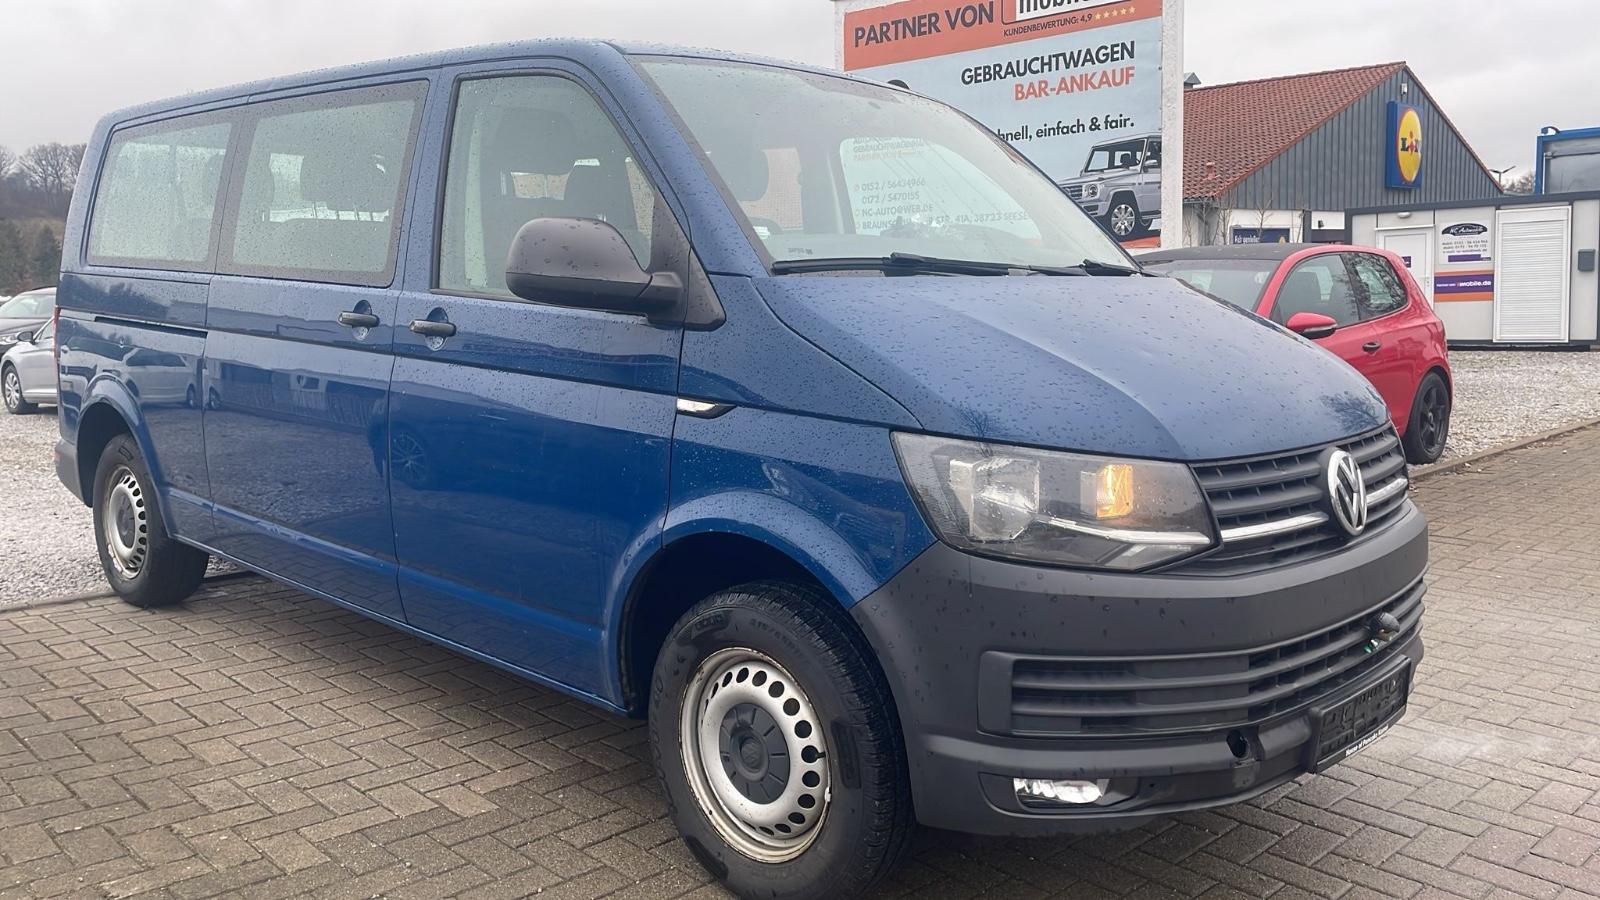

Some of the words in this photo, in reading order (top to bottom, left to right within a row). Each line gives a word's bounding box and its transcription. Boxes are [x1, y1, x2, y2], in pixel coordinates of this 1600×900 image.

[854, 12, 941, 48] PARTNER
[945, 1, 994, 31] VON
[1003, 16, 1079, 37] KUNDENBEWERTUNG:
[1080, 13, 1093, 23] 4,9
[961, 40, 1135, 85] GEBRAUCHTWAGEN
[1014, 66, 1136, 101] BAR-ANKAUF
[997, 125, 1032, 142] hnell,
[1036, 118, 1085, 138] einfach
[1089, 116, 1101, 132] &
[1104, 113, 1135, 130] fair.
